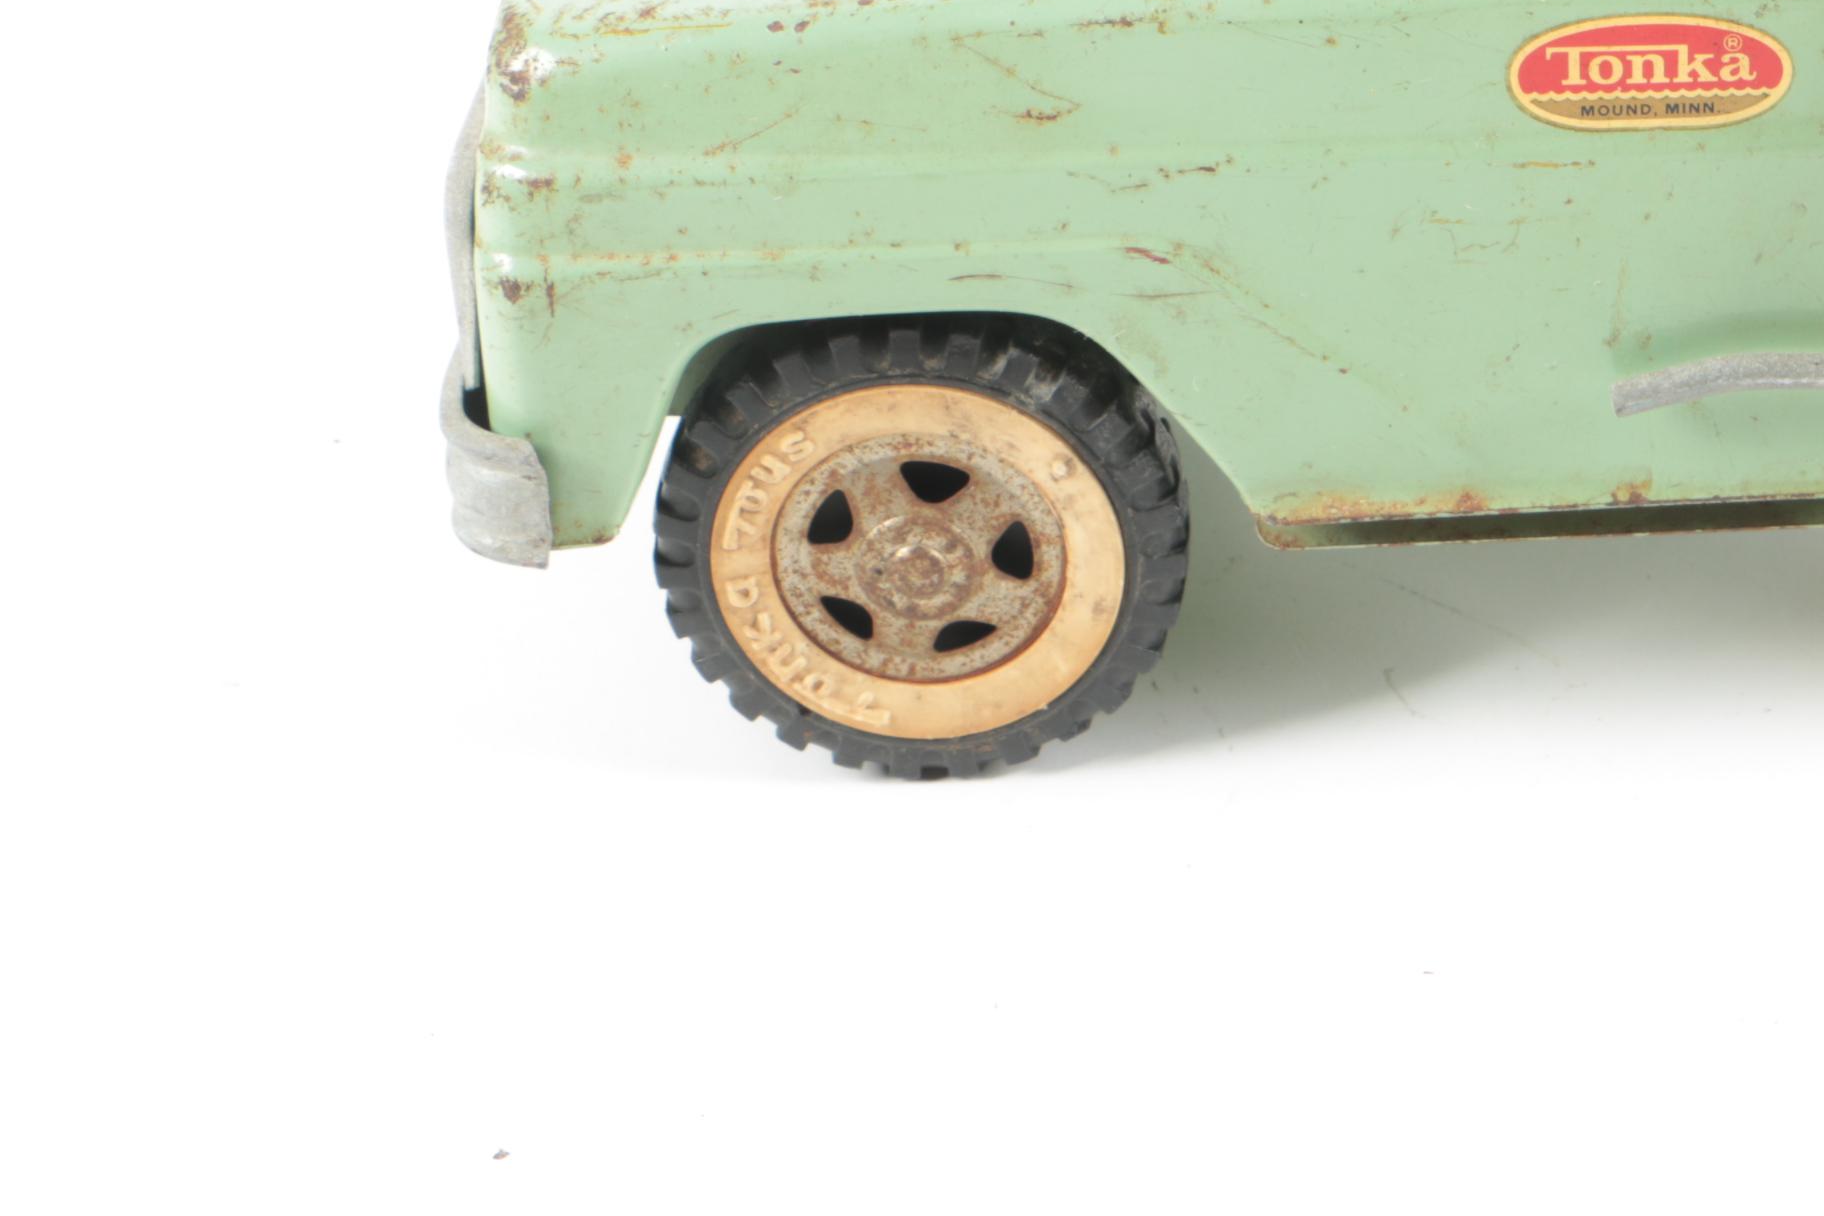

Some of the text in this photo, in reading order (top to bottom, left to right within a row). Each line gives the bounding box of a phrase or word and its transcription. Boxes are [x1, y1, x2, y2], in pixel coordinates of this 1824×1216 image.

[1545, 44, 1758, 86] Tonka
[1580, 101, 1721, 118] MOUND, MINN.
